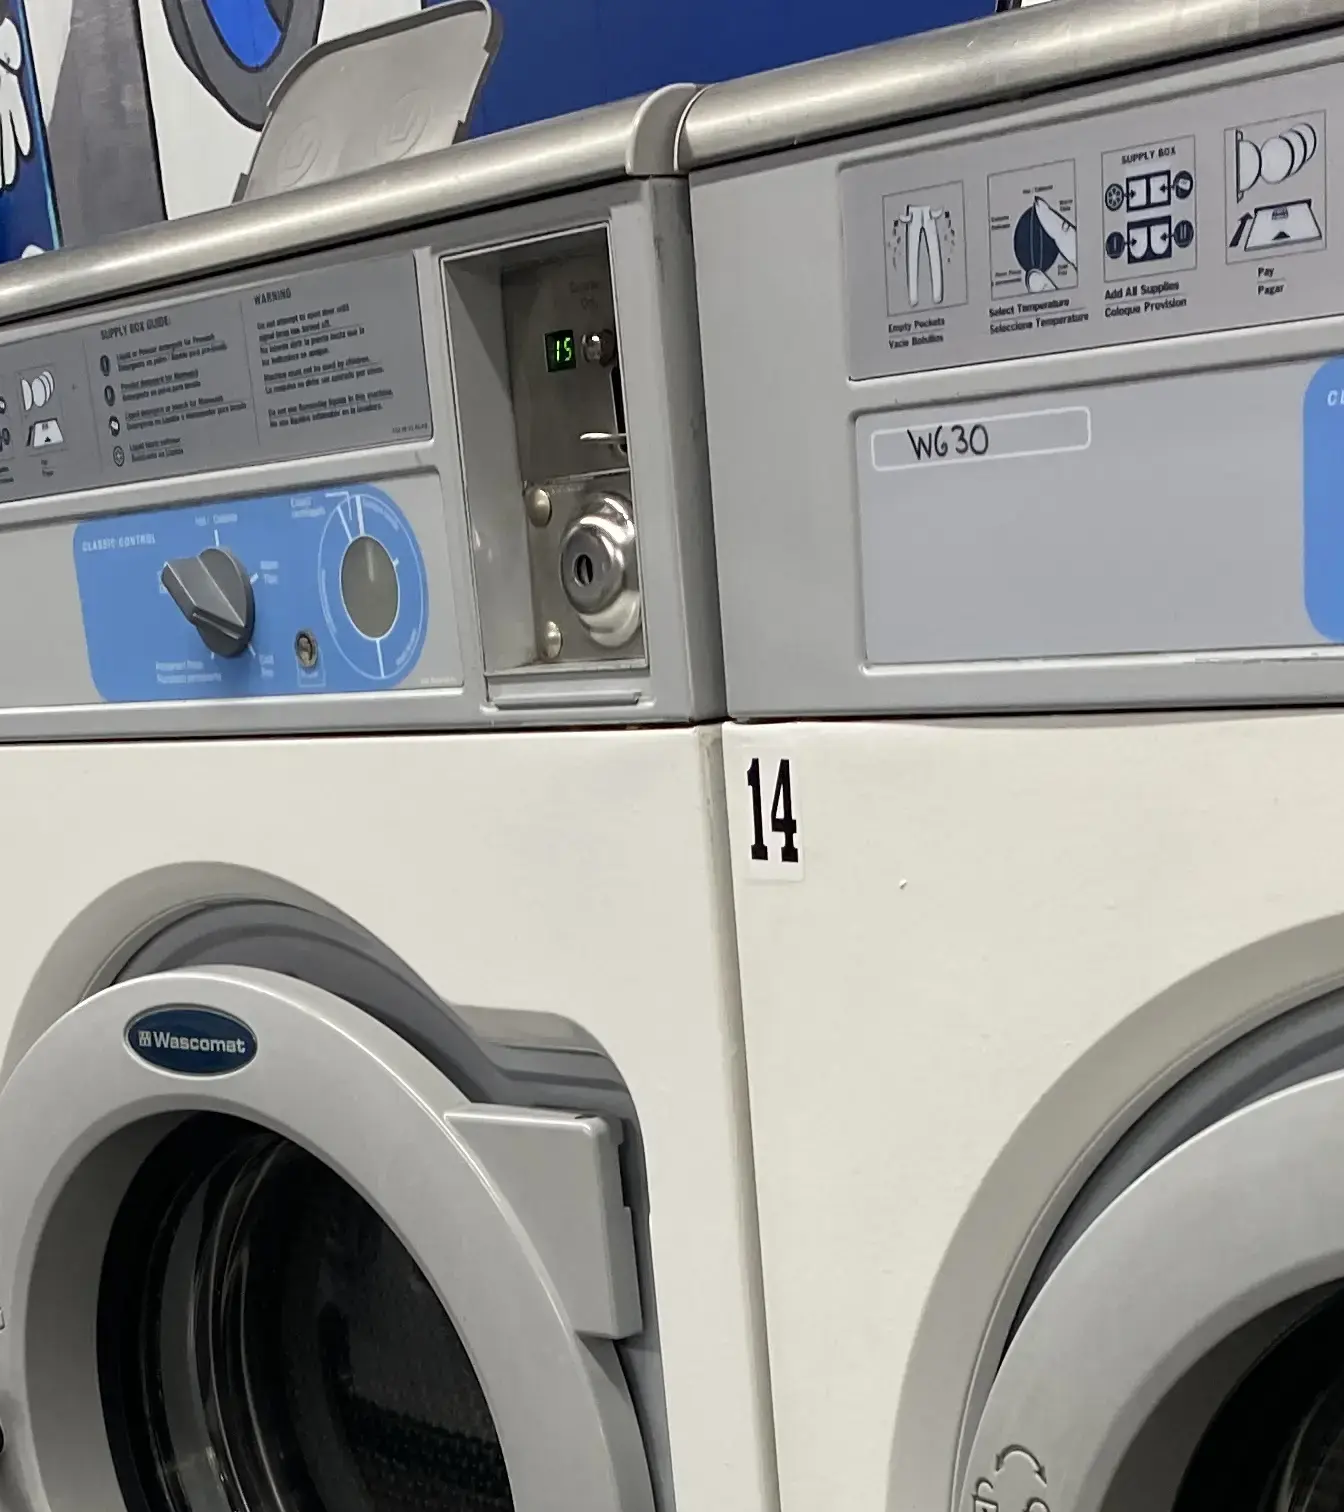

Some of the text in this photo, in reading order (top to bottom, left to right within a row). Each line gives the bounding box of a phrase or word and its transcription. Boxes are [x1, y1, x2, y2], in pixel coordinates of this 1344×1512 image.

[1121, 150, 1157, 165] SUPPLY
[1257, 267, 1275, 278] Pay
[1104, 288, 1123, 300] Add
[1140, 281, 1180, 296] Supplies
[989, 306, 1015, 319] Select
[1104, 297, 1187, 318] Coloque Provision
[888, 320, 912, 334] Empty
[556, 337, 573, 362] 15
[747, 757, 799, 863] 14
[152, 1031, 246, 1054] Wascomat
